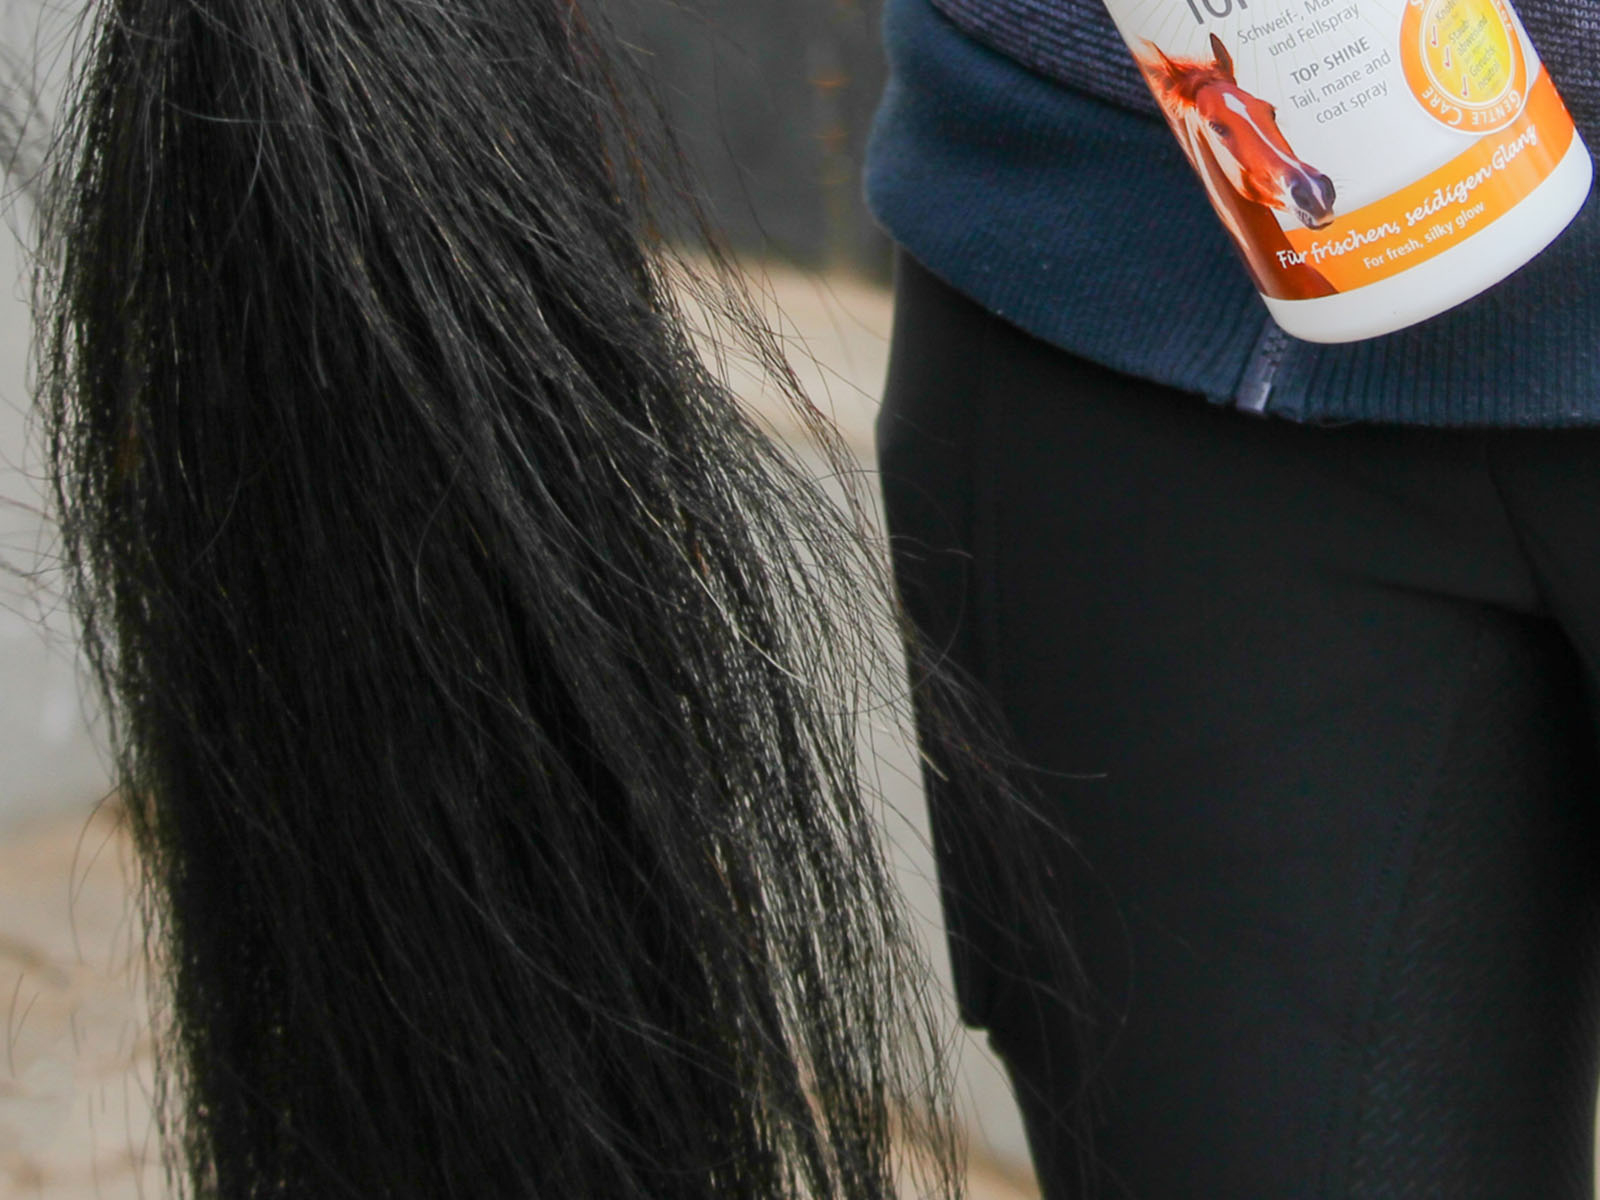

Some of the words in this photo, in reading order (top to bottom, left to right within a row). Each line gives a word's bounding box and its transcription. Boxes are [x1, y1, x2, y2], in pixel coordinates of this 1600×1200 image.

[1237, 8, 1305, 44] Schweif-,
[1268, 34, 1297, 56] und
[1297, 2, 1360, 43] Fellspray
[1290, 62, 1320, 85] TOP
[1323, 35, 1371, 71] SHINE
[1290, 88, 1320, 109] Tail,
[1321, 68, 1361, 97] mane
[1365, 48, 1392, 75] and
[1316, 99, 1348, 124] coat
[1350, 79, 1389, 109] spray
[1421, 86, 1463, 125] CARE
[1310, 220, 1401, 265] frischen,
[1403, 163, 1493, 227] seidigen
[1491, 123, 1538, 171] Glanz
[1363, 253, 1386, 270] For
[1386, 234, 1425, 259] fresh,
[1424, 219, 1455, 244] silky
[1455, 200, 1486, 229] glow
